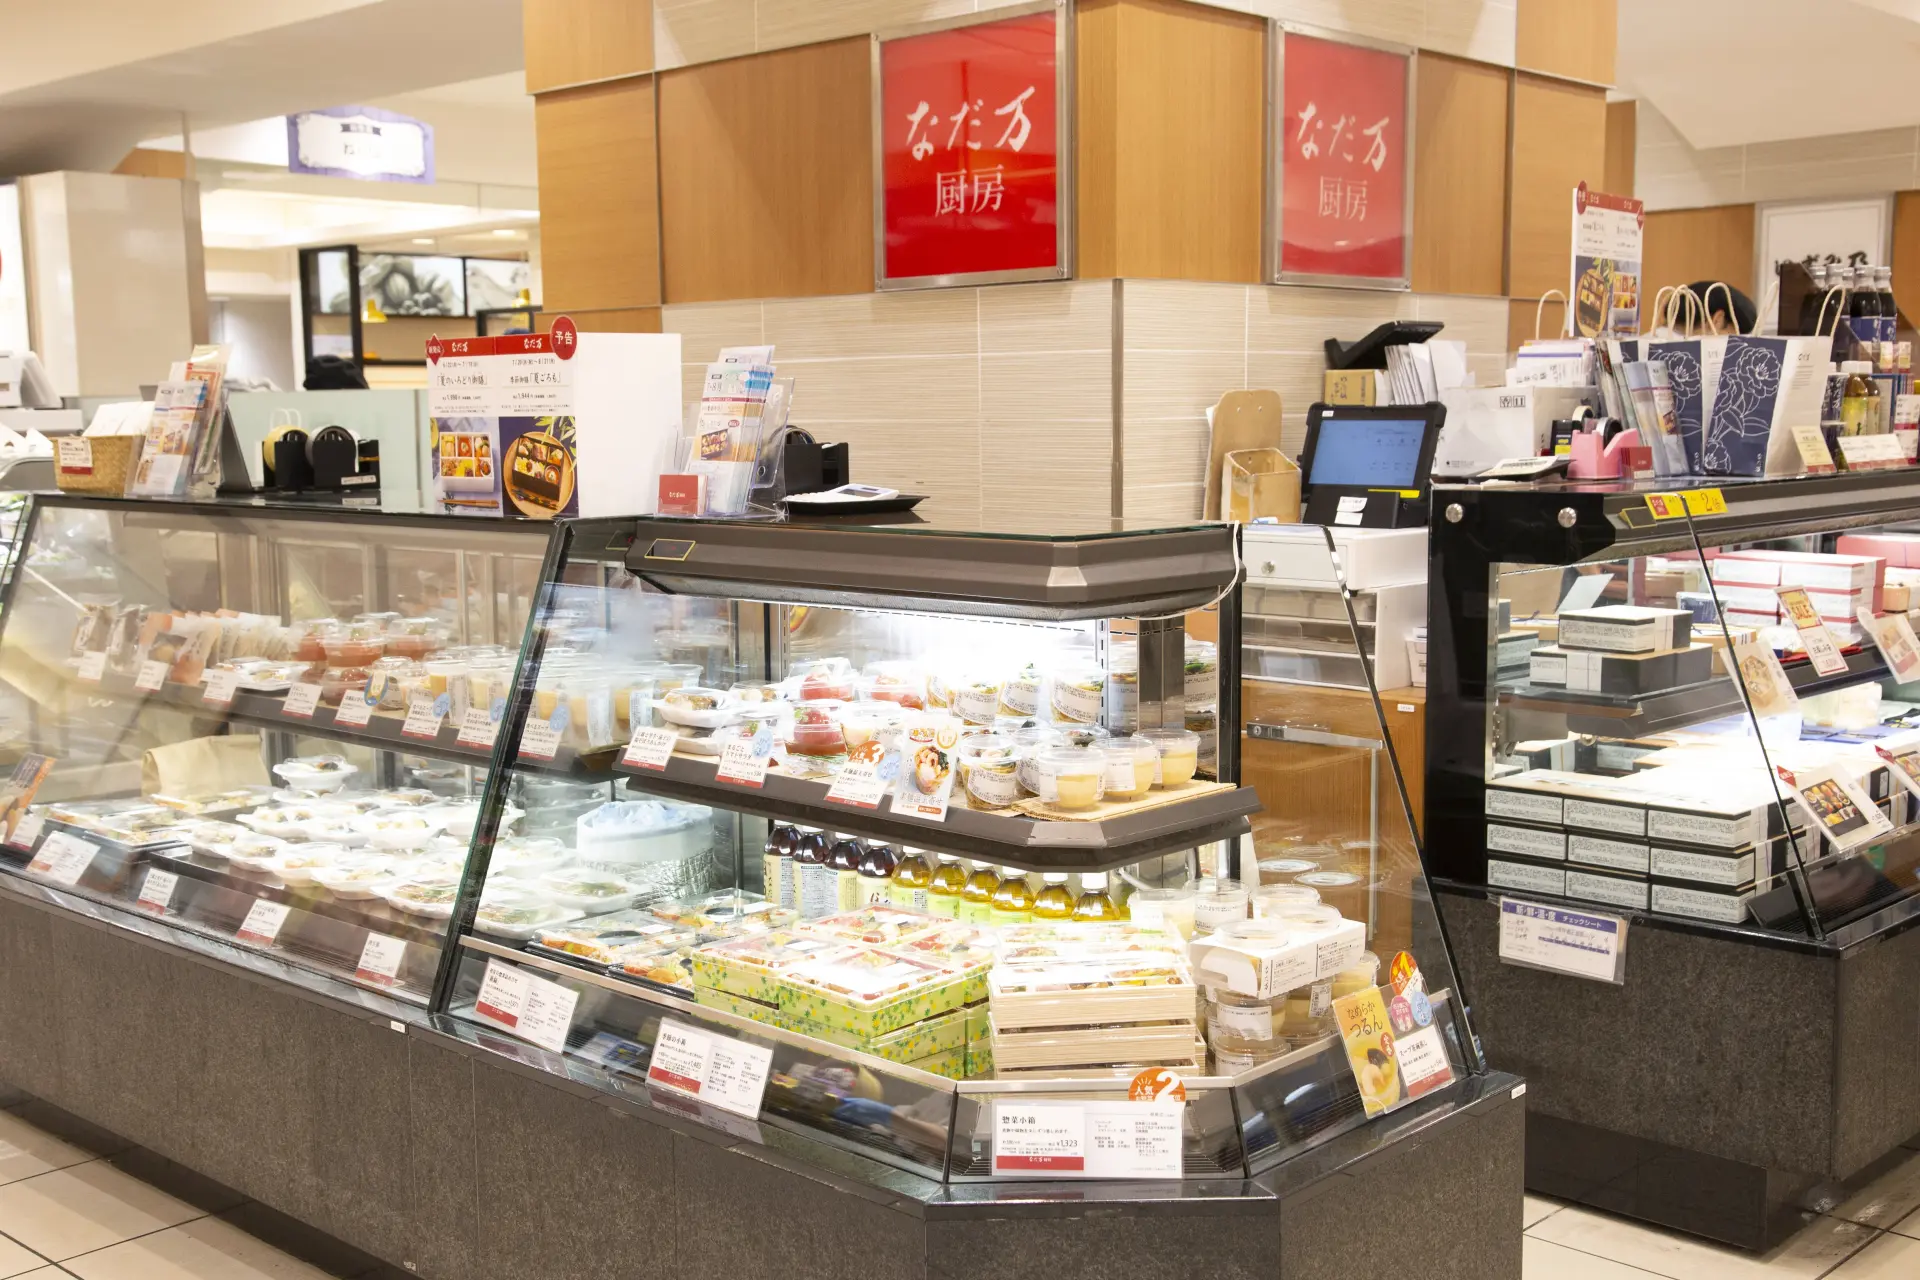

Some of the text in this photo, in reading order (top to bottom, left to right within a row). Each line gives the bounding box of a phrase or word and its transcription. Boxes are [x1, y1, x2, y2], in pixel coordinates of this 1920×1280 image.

[906, 85, 1035, 161] なだ万
[1296, 102, 1391, 172] なだ万
[934, 164, 1006, 217] 厨房
[1318, 175, 1369, 223] 厨房
[523, 337, 543, 350] なだ万
[555, 330, 574, 345] 予告
[1562, 914, 1602, 929] チェックシート
[1346, 1000, 1376, 1019] なめらか
[1349, 1014, 1383, 1038] つるん
[1134, 1085, 1154, 1095] 人気
[1001, 1115, 1036, 1125] 惣菜小箱
